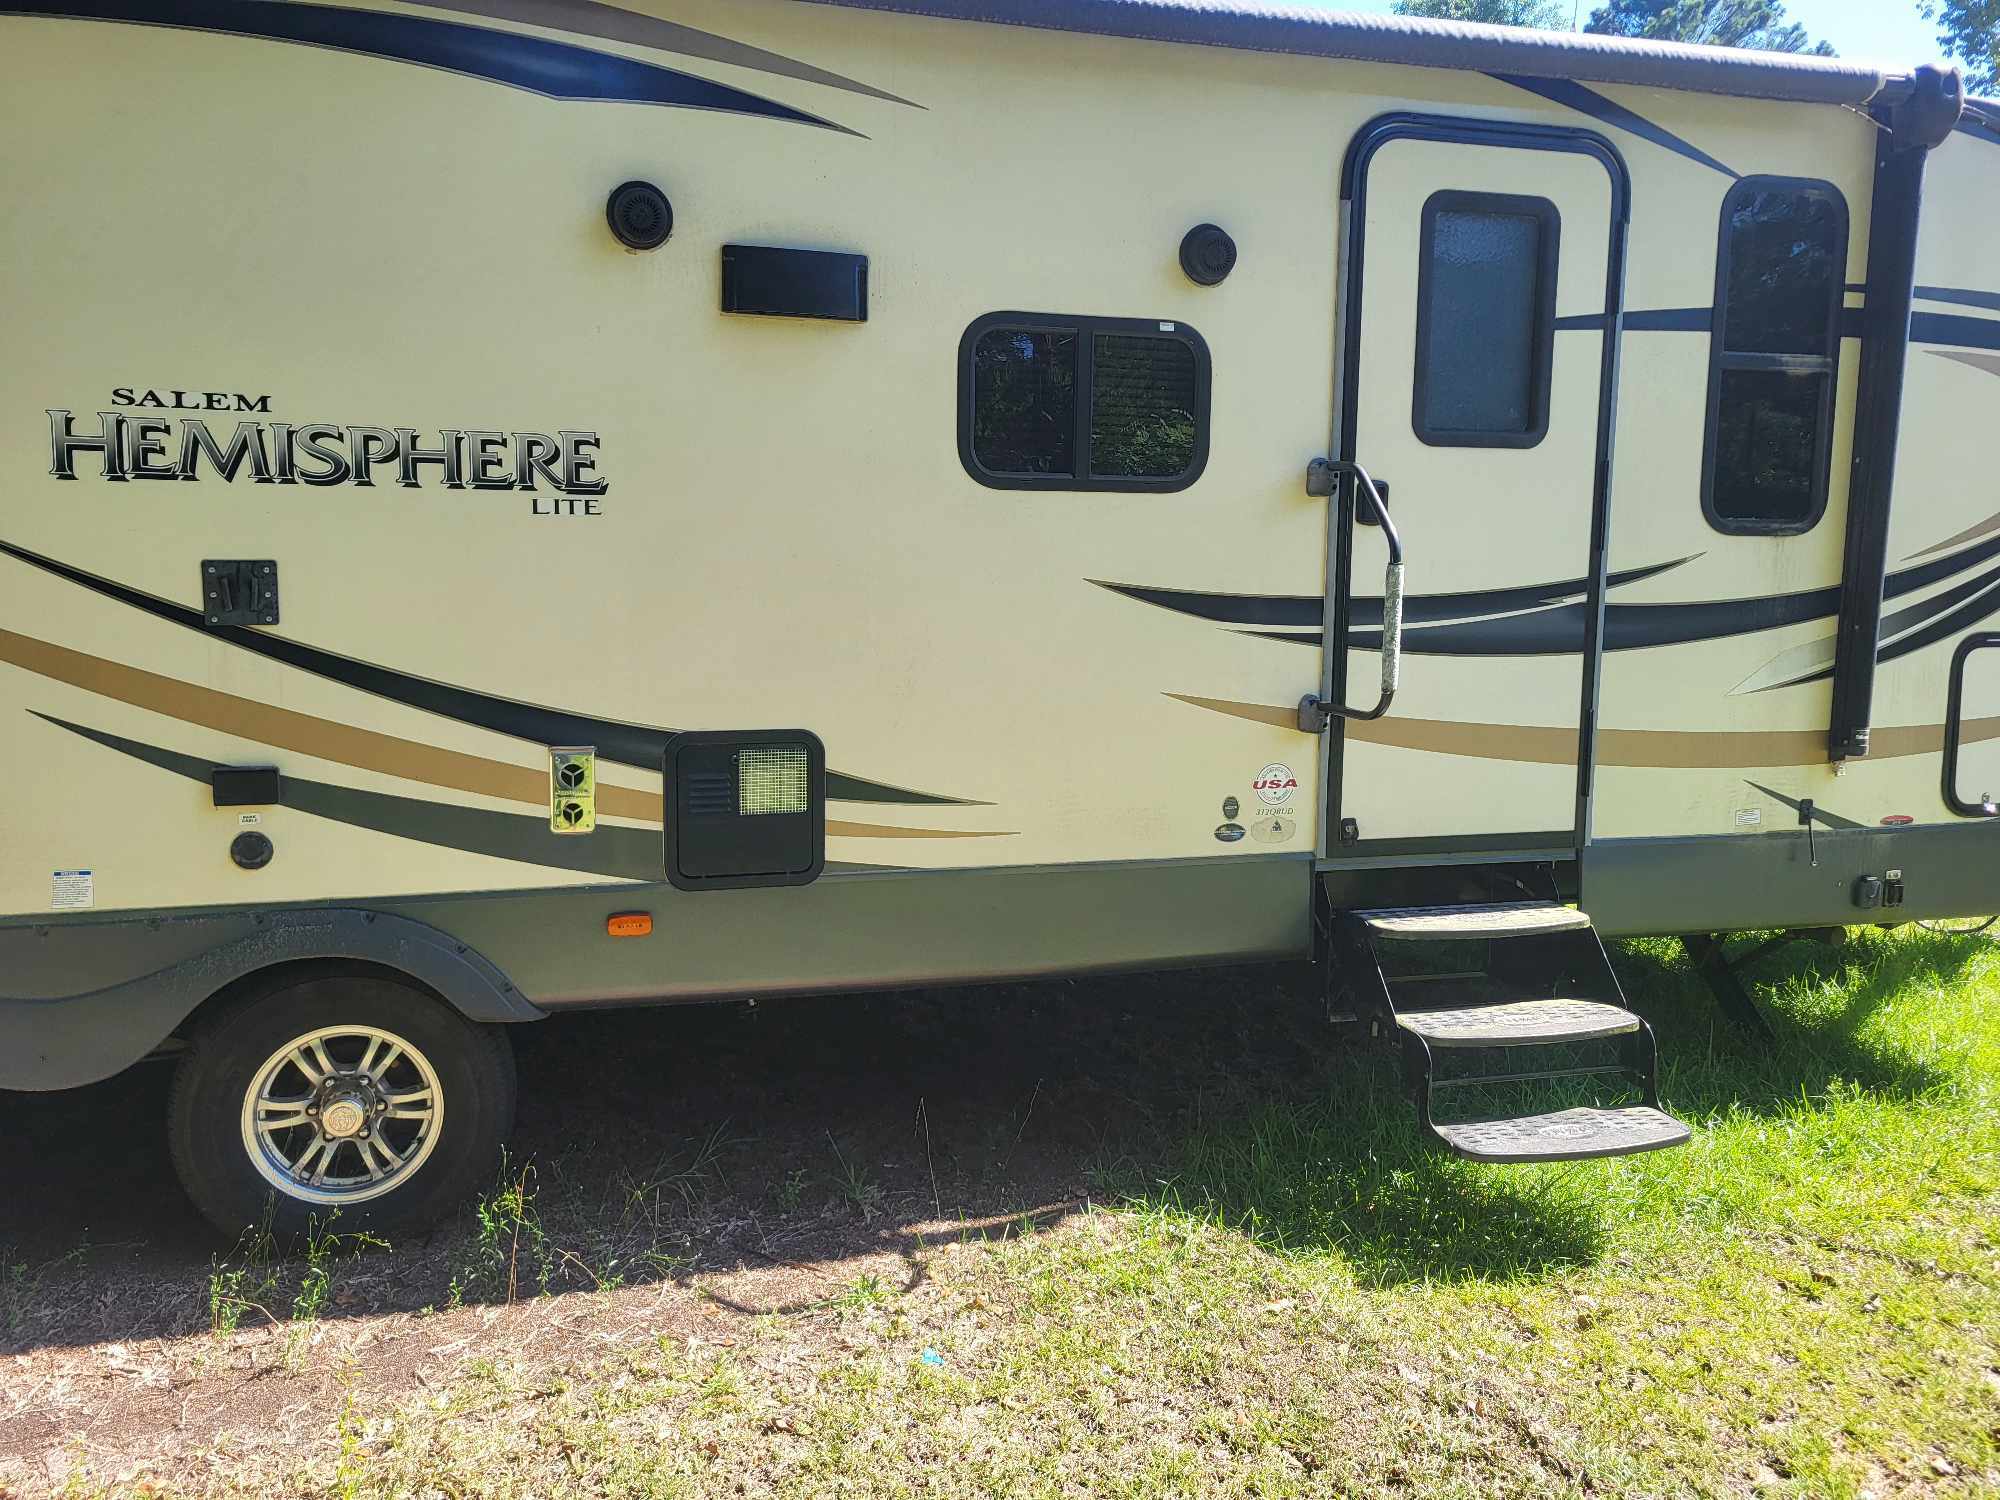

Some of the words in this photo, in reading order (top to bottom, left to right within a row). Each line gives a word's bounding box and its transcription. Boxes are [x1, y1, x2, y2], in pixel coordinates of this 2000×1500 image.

[111, 388, 272, 412] SALEM
[45, 408, 609, 496] HEMISPHERE
[531, 498, 603, 516] LITE
[1253, 779, 1297, 790] USA
